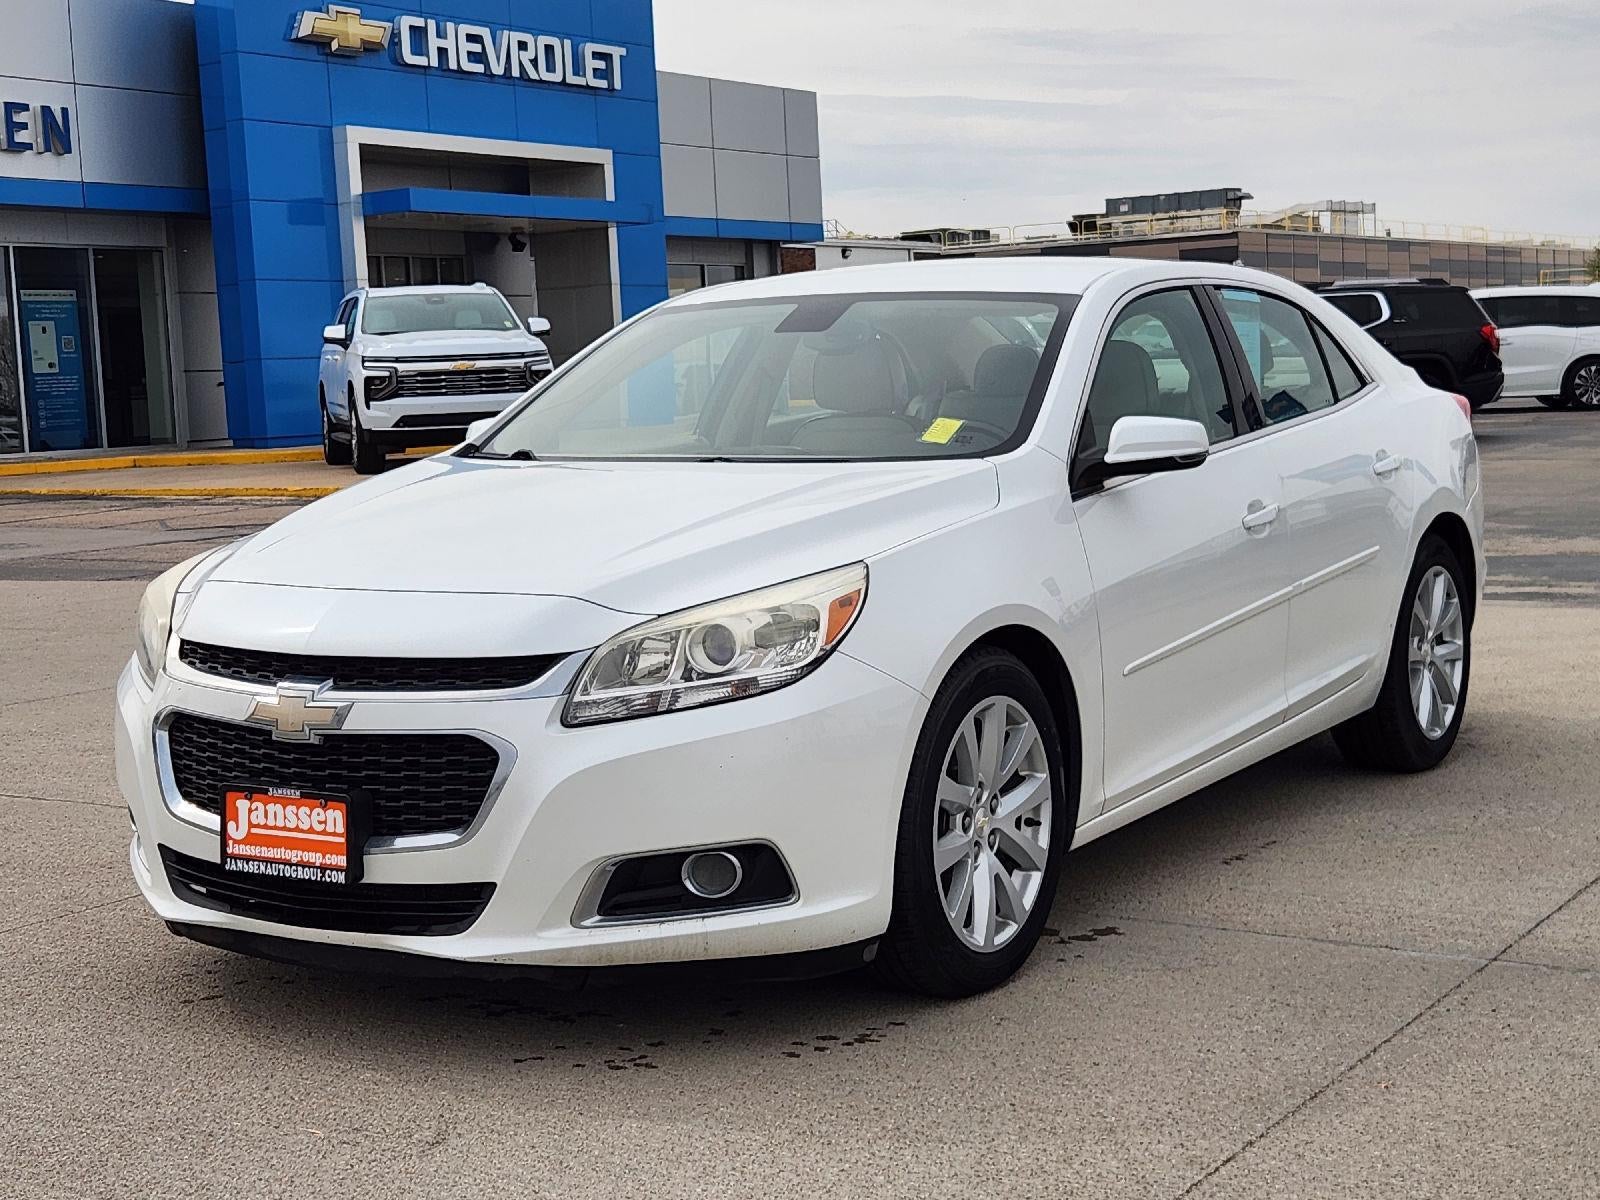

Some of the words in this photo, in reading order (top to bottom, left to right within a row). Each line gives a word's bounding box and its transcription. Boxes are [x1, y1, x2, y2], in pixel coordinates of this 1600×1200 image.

[399, 15, 627, 91] CHEVROLET
[267, 787, 301, 798] JANSSEN
[227, 799, 345, 840] Janssen
[226, 840, 347, 867] Janssenautogroup.com
